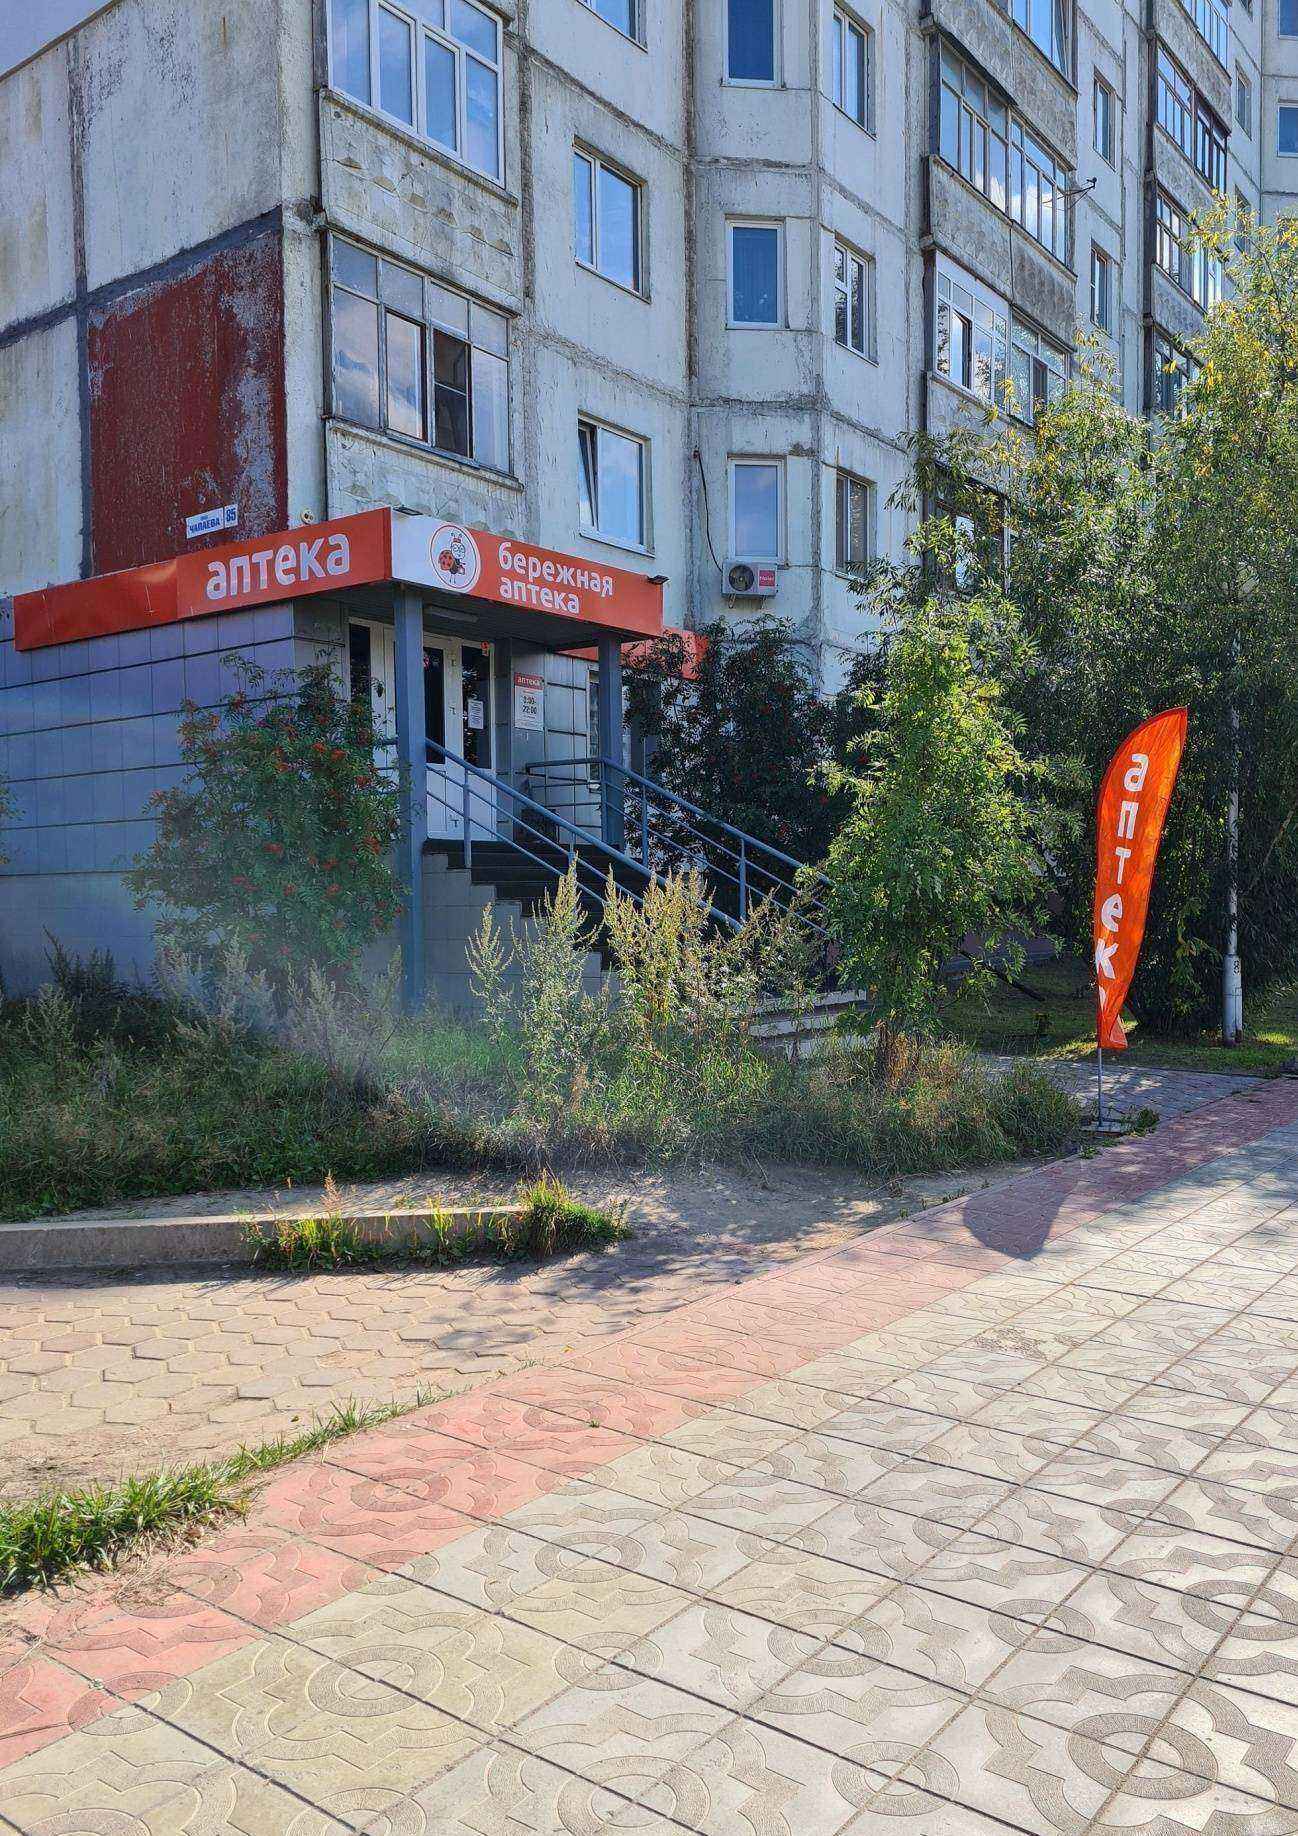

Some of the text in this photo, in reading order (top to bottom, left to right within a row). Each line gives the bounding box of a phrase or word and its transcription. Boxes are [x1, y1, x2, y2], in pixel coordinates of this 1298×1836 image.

[190, 517, 220, 532] ЧАПАЕВА
[226, 508, 236, 521] 85
[206, 533, 350, 600] аптека
[499, 541, 613, 598] бережная
[500, 577, 580, 614] аптека
